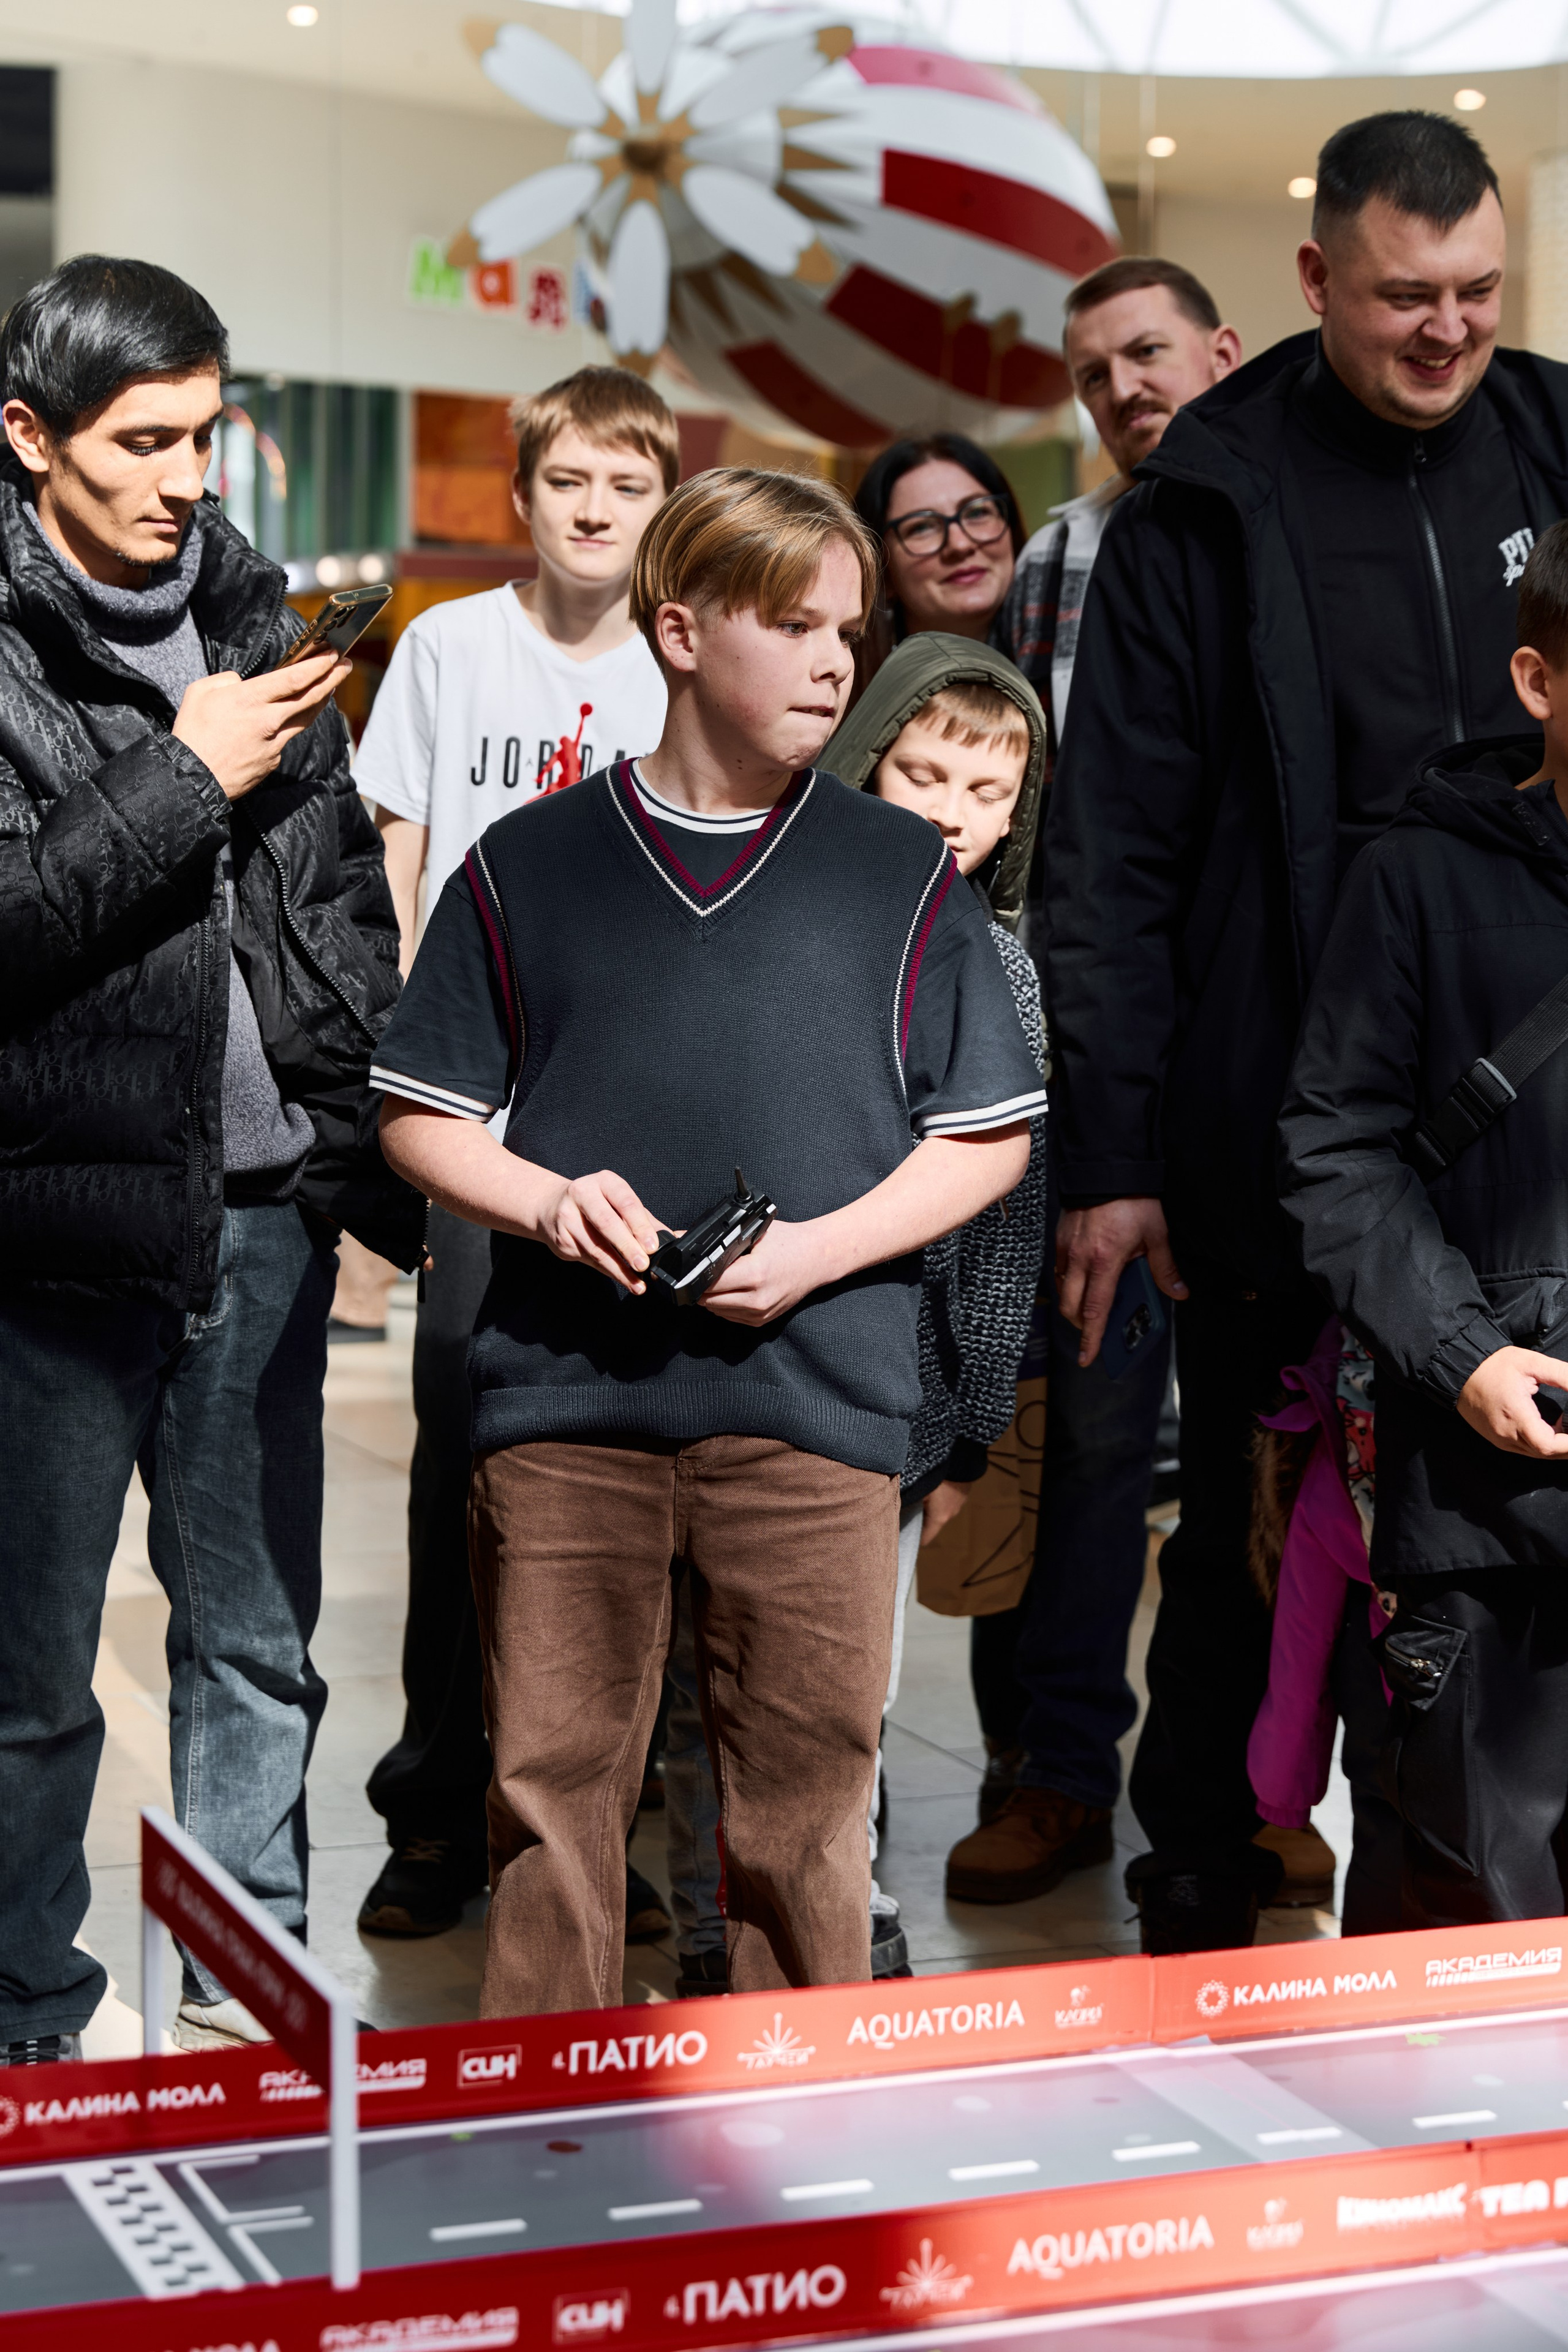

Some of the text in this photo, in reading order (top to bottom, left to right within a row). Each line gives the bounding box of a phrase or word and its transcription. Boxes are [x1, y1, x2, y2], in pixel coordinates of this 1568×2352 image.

[1425, 1947, 1562, 1978] АКАДЕМИЯ
[1234, 1969, 1396, 2007] КАЛИНА МОЛЛ
[846, 1999, 1025, 2050] AQUATORIA
[568, 2030, 707, 2075] ПАТИО
[24, 2082, 227, 2125] КАЛИНА МОЛЛ
[1006, 2214, 1215, 2280] AQUATORIA
[683, 2264, 848, 2326] ПАТИО
